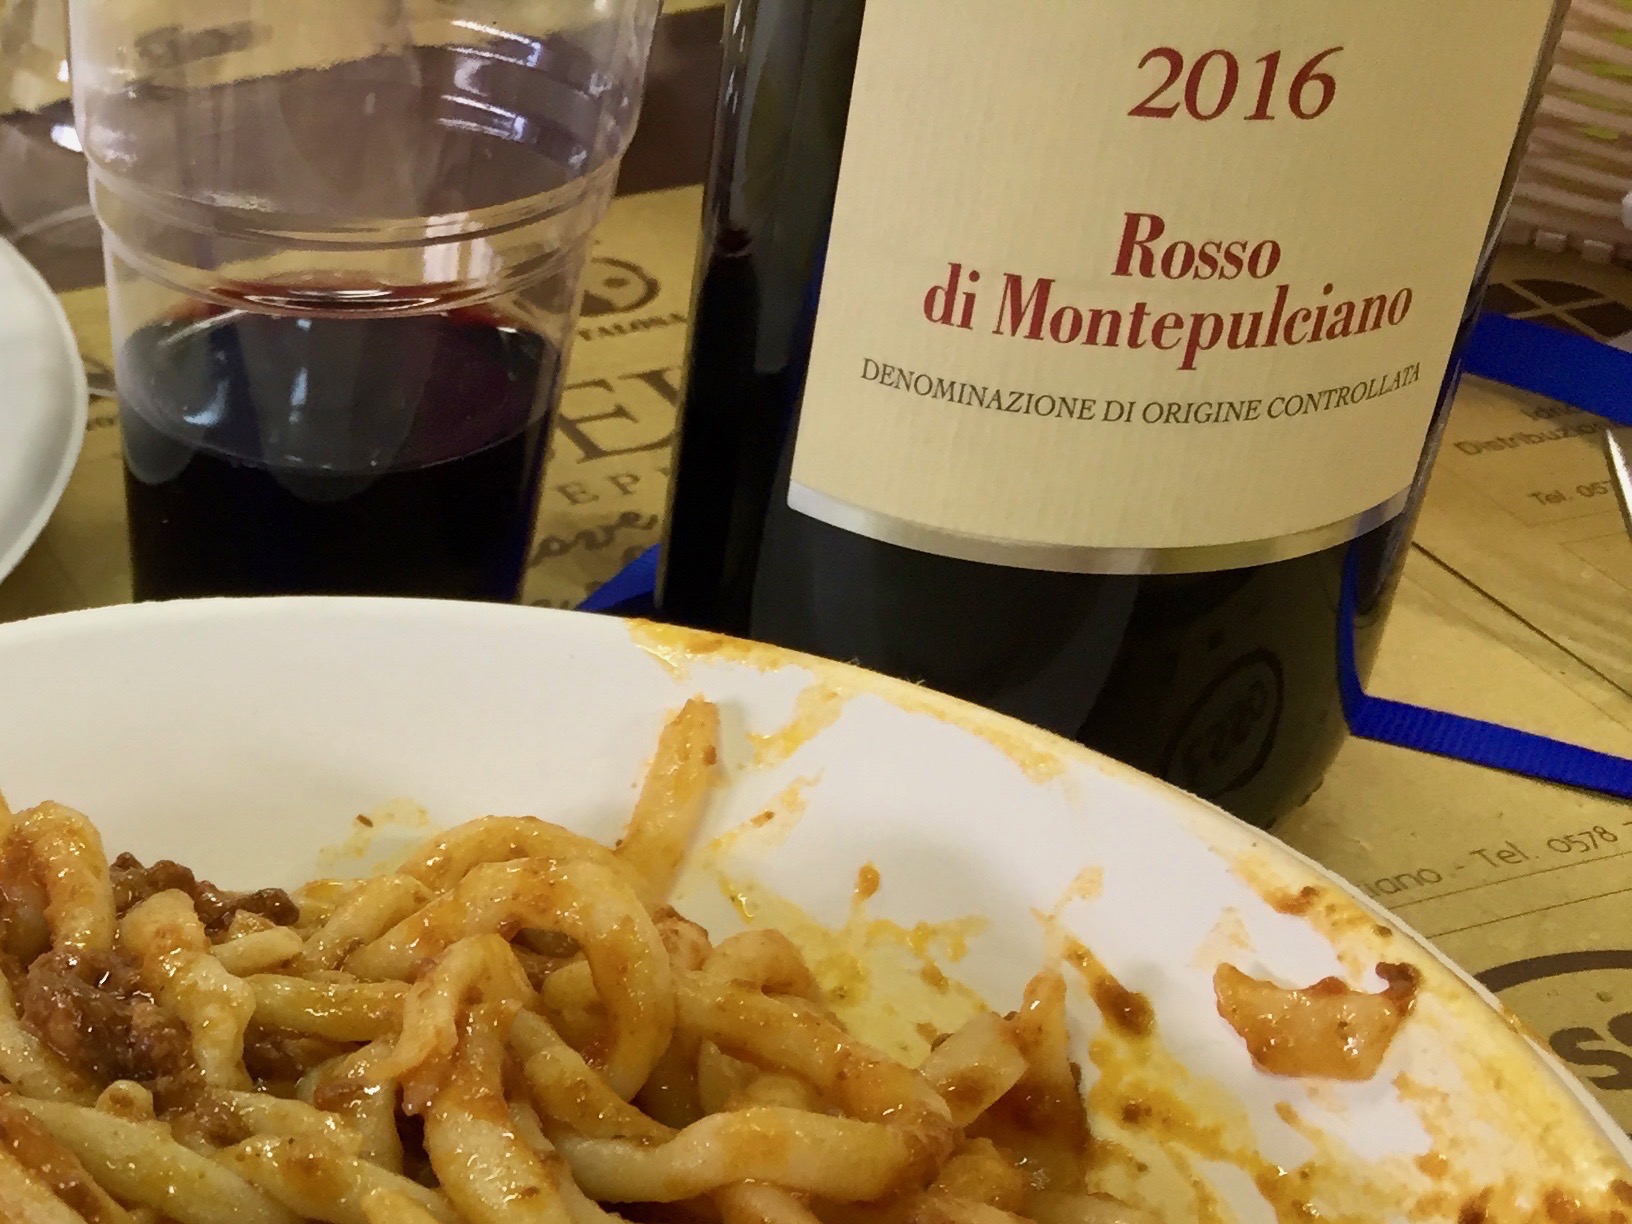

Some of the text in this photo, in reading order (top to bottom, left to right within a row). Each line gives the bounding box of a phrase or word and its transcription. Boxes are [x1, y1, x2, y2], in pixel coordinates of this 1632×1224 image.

[1126, 46, 1344, 121] 2016
[1110, 211, 1282, 280] Rosso
[922, 262, 1414, 371] di Montepulciano
[861, 356, 1421, 425] DENOMINAZIONE DI ORIGINE CONTROLLATA
[1469, 840, 1540, 869] Tel.
[1546, 825, 1619, 854] 0578
